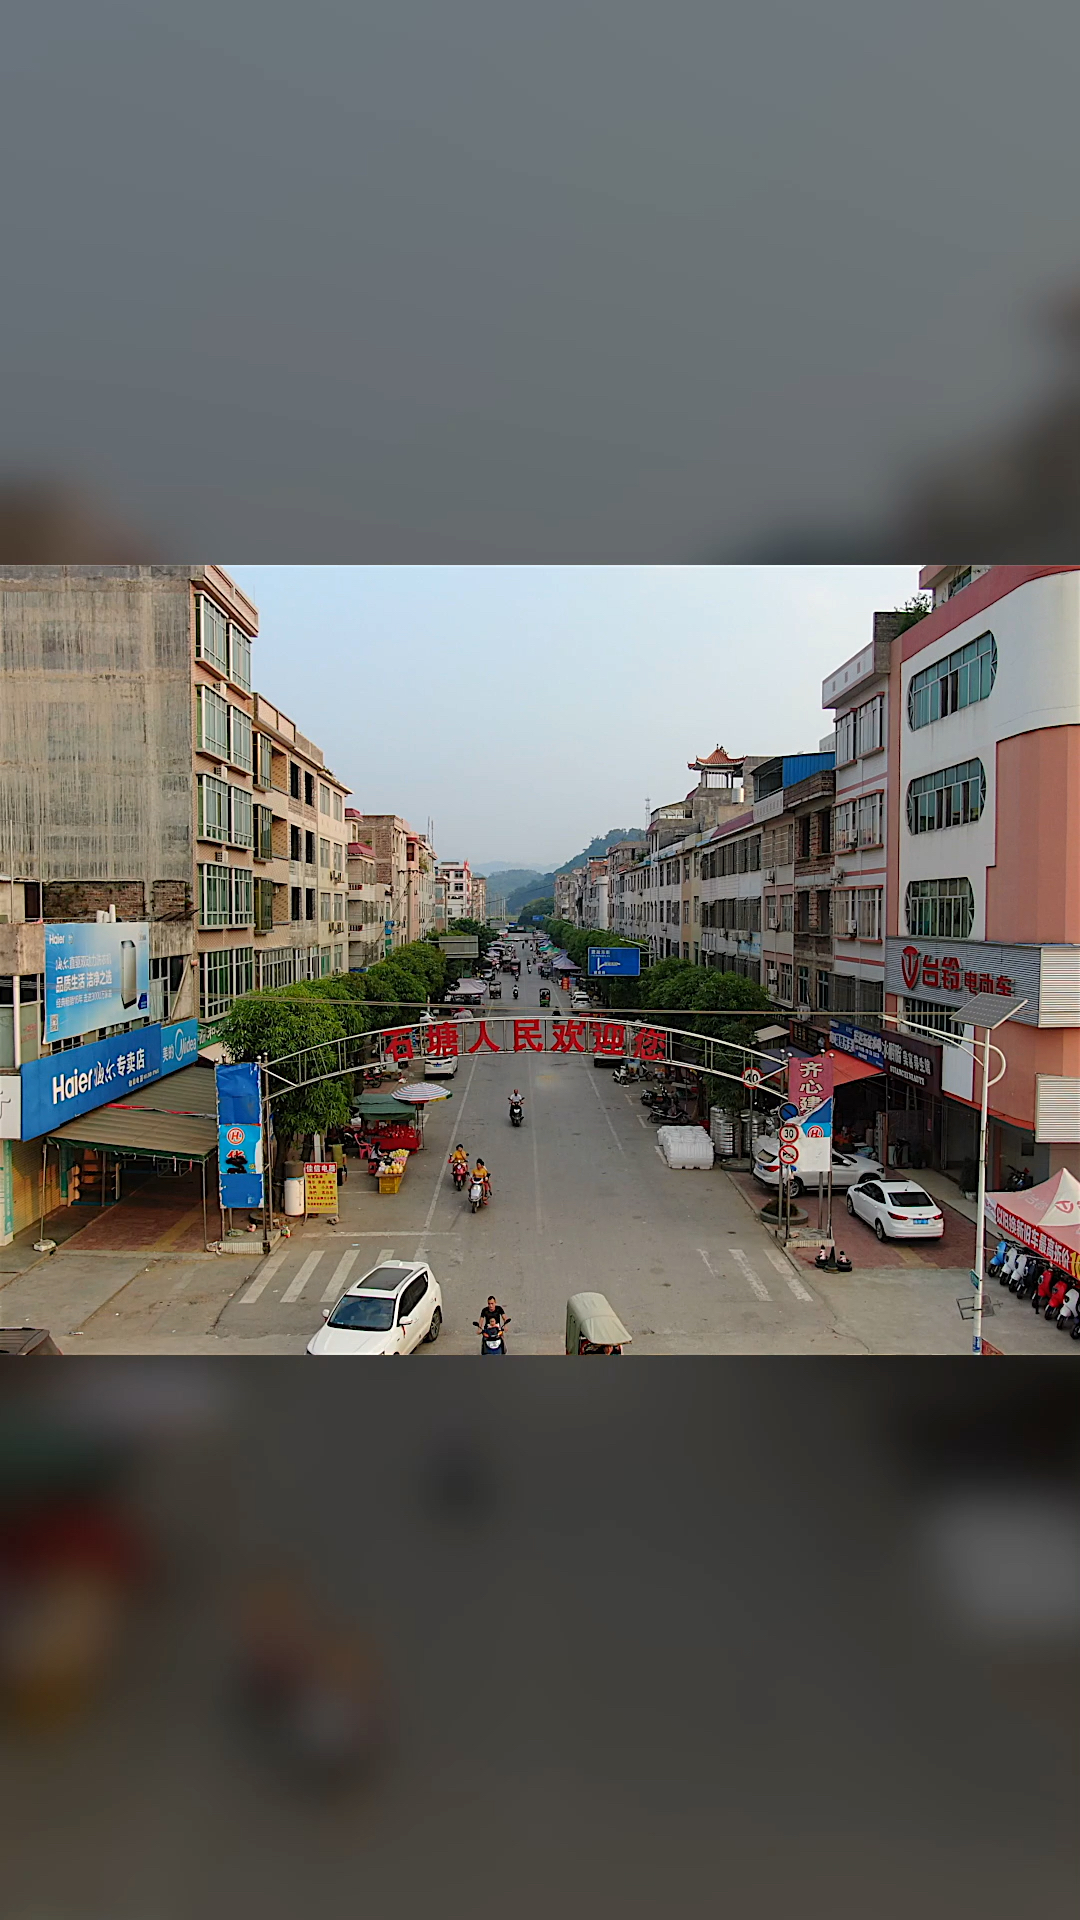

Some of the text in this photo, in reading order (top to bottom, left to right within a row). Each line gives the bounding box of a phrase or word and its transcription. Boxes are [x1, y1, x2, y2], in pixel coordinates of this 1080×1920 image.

[49, 934, 65, 945] Haier
[56, 970, 112, 993] 品质生活 洁净之选
[922, 955, 1015, 997] 台铃 电动车
[382, 1019, 667, 1061] 石塘人民欢迎您
[162, 1044, 174, 1062] 美的
[52, 1068, 92, 1104] Haier
[94, 1048, 145, 1087] 海尔专卖店
[784, 1129, 794, 1138] 30
